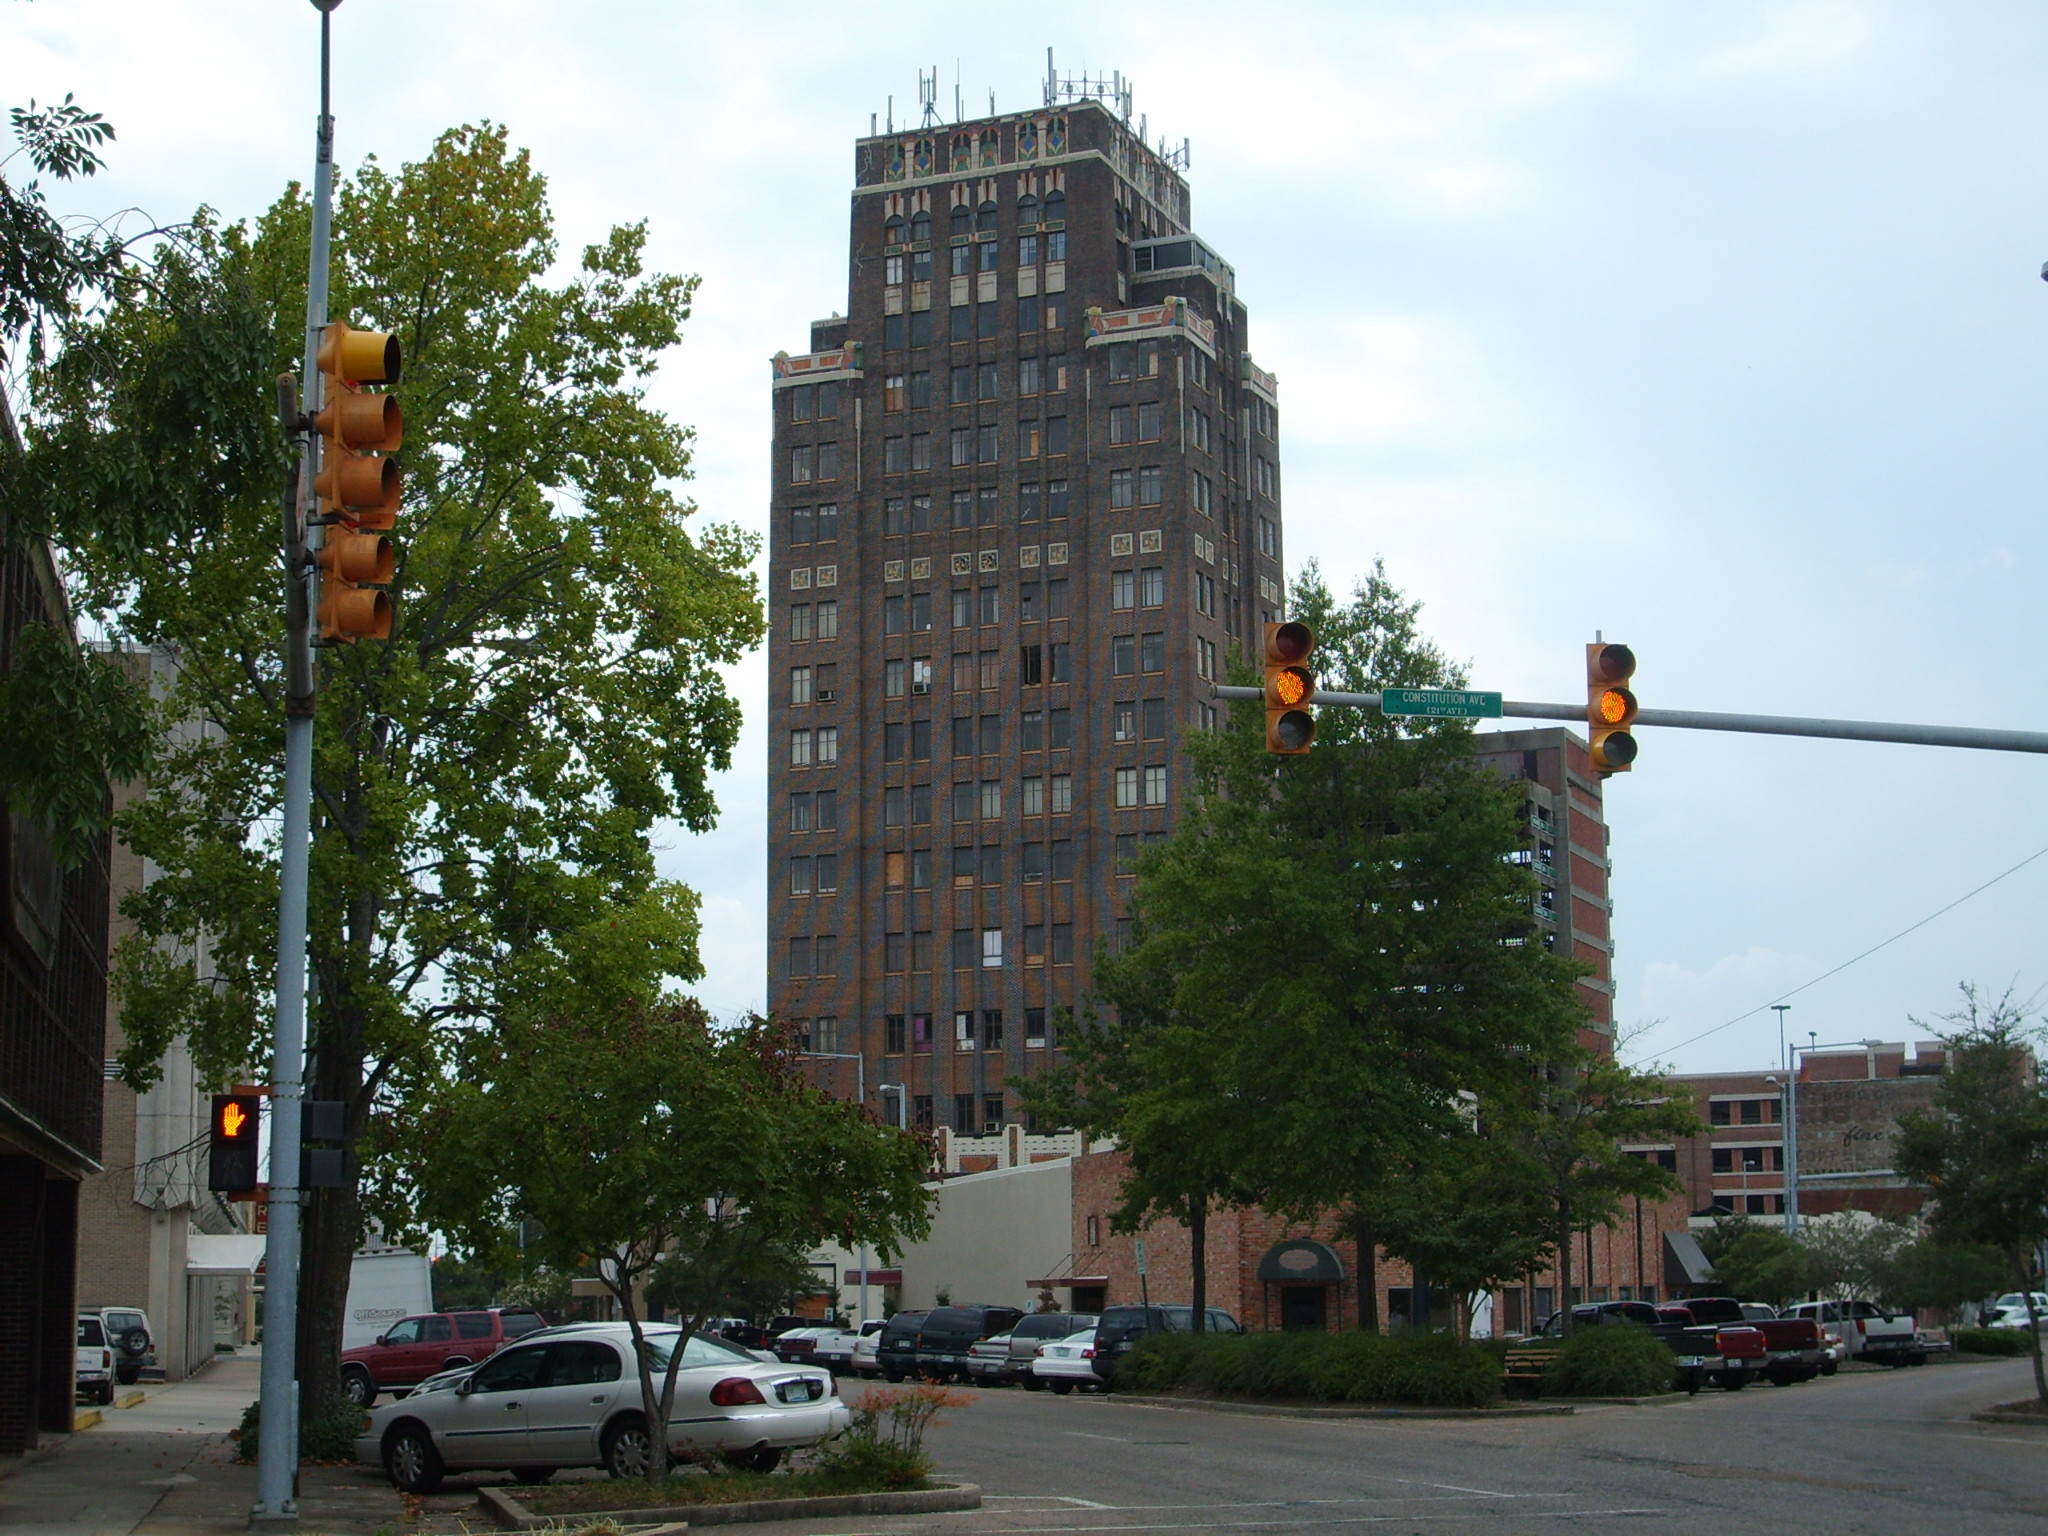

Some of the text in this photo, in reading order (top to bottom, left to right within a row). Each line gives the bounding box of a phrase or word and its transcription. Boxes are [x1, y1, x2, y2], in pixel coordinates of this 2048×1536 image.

[1402, 691, 1486, 706] CONSTITUTION AVE
[1446, 707, 1468, 716] AVE)
